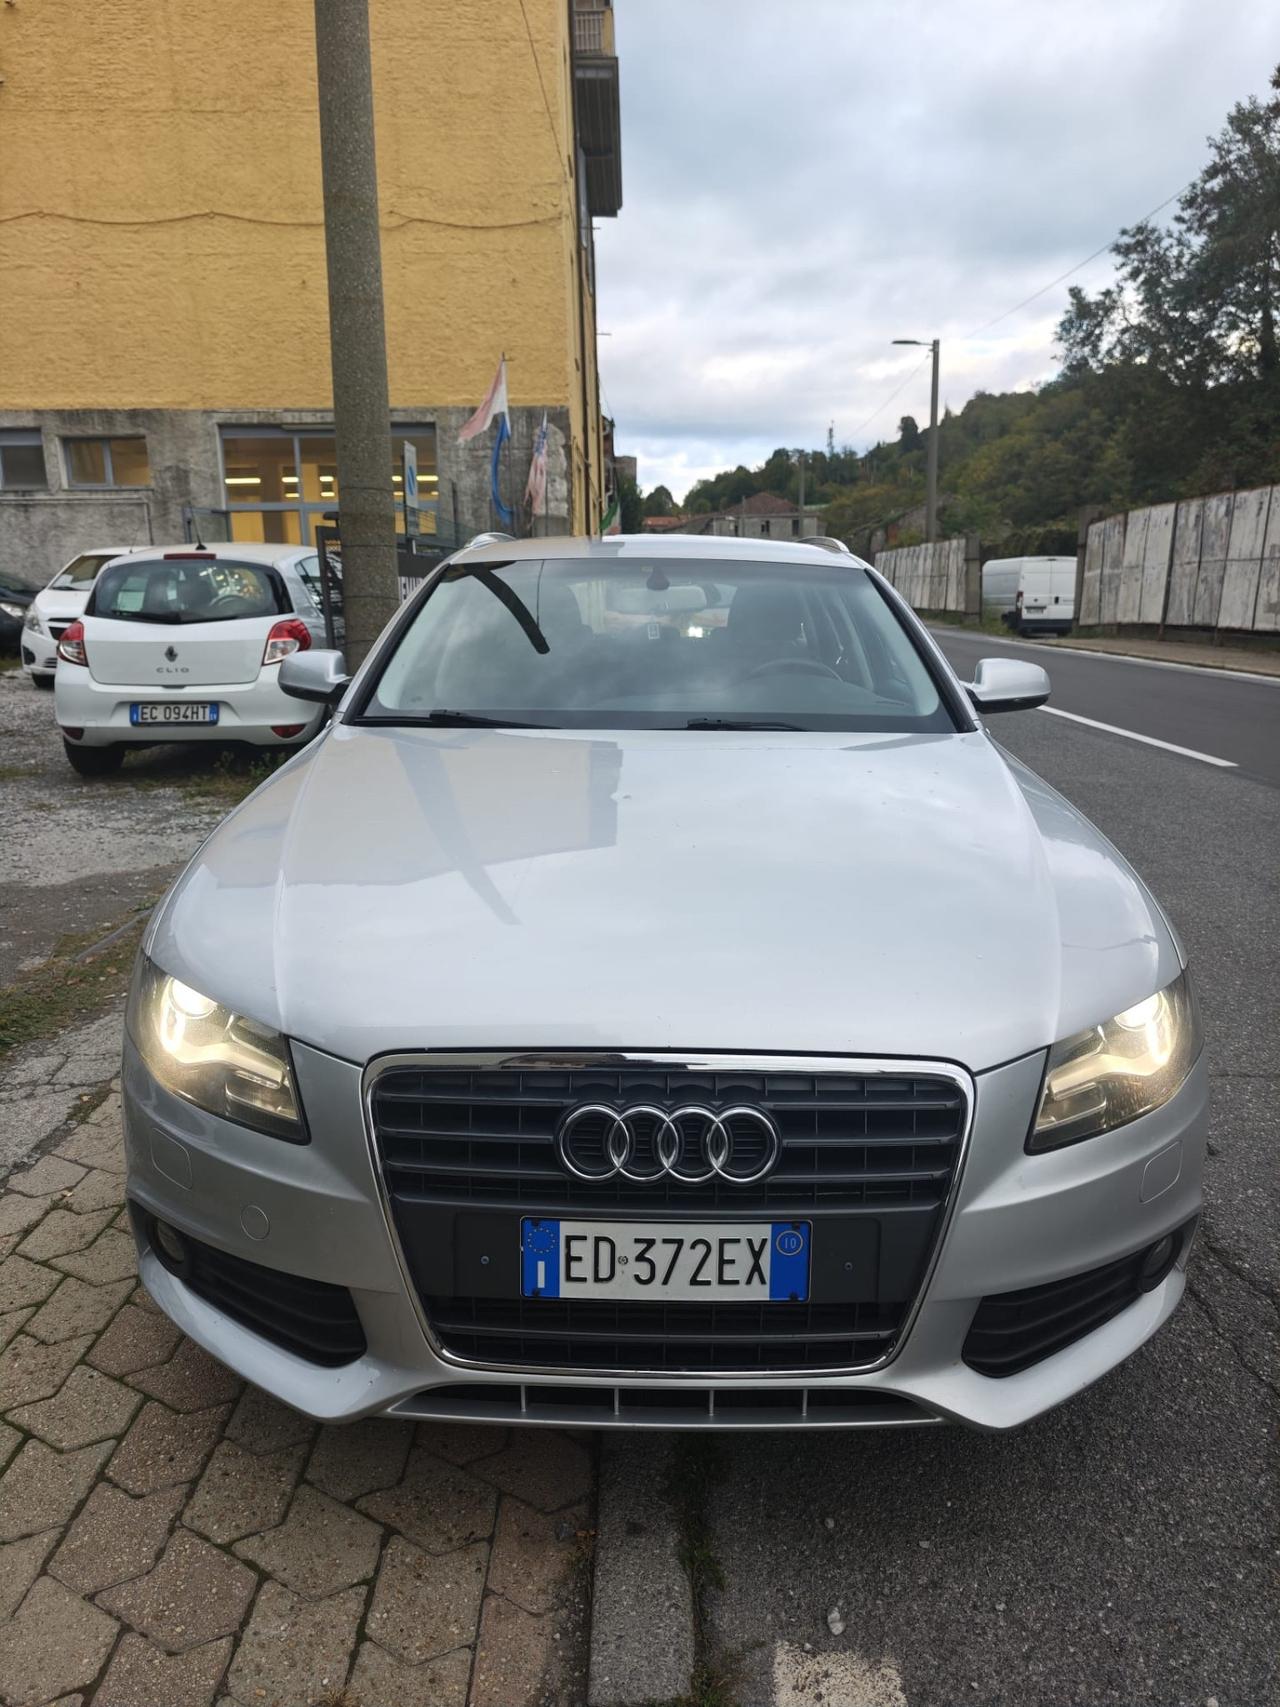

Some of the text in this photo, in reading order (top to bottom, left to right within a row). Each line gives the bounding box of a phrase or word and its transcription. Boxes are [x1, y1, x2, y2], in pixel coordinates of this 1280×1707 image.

[141, 706, 158, 720] EC
[164, 706, 208, 720] 094HT
[565, 1235, 768, 1286] ED 372EX
